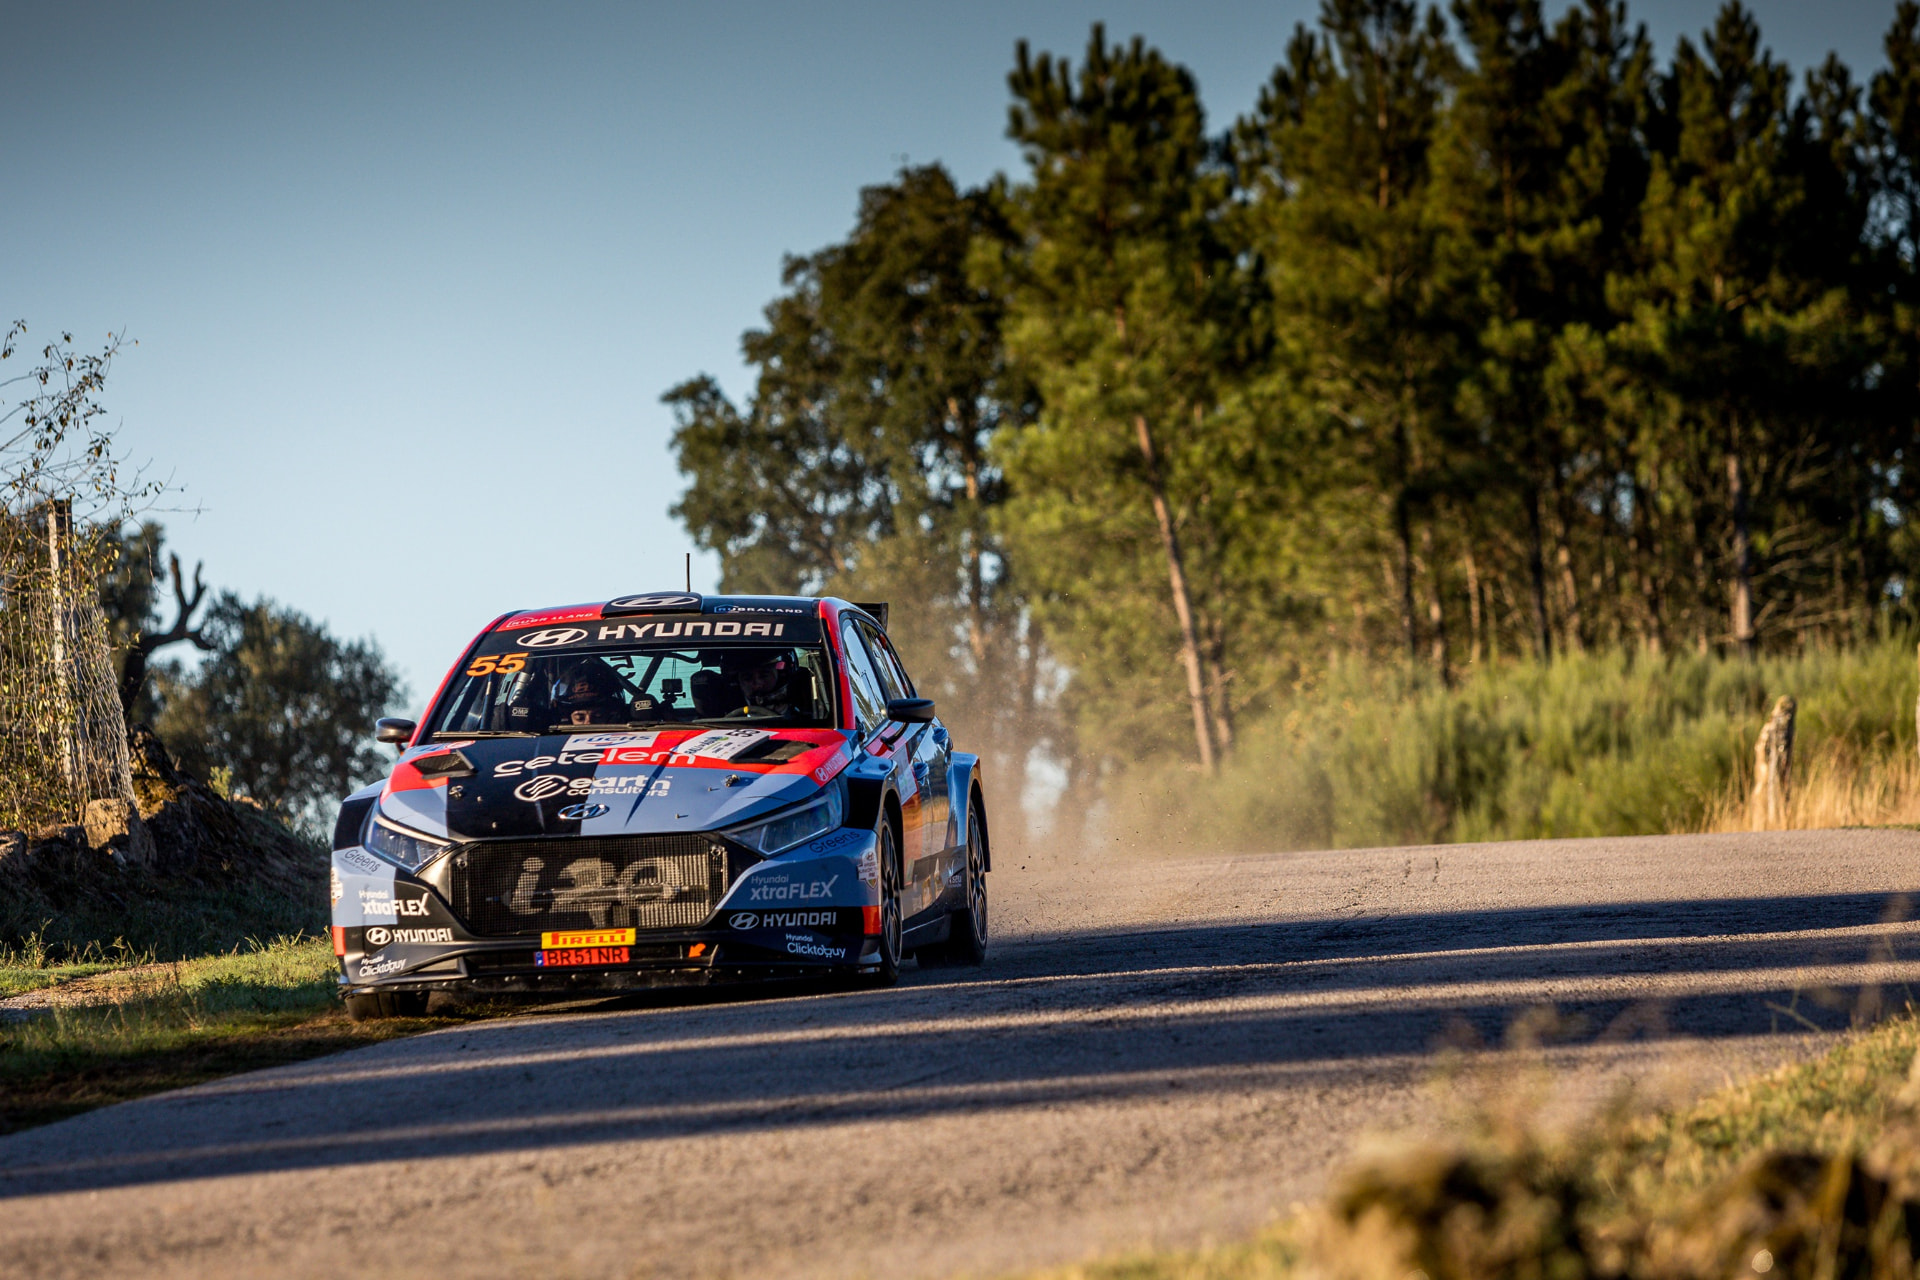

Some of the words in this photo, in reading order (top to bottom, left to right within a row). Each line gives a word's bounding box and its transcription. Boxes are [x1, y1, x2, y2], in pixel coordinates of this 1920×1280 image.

[717, 605, 804, 614] RUBRALAND
[598, 622, 784, 640] HYUNDAI
[466, 653, 529, 677] 55
[511, 707, 529, 716] OMP
[572, 735, 654, 744] FUCHS
[494, 749, 697, 777] cetelem
[568, 775, 671, 791] earth
[809, 831, 860, 854] Greens
[344, 849, 381, 873] Greens
[751, 874, 789, 884] Hyundai
[751, 875, 839, 900] xtraFLEX
[361, 892, 430, 916] xtraFLEX
[763, 912, 837, 927] HYUNDAI
[392, 928, 453, 942] HYUNDAI
[551, 929, 627, 945] PIRELLI
[786, 933, 813, 942] Hyundai
